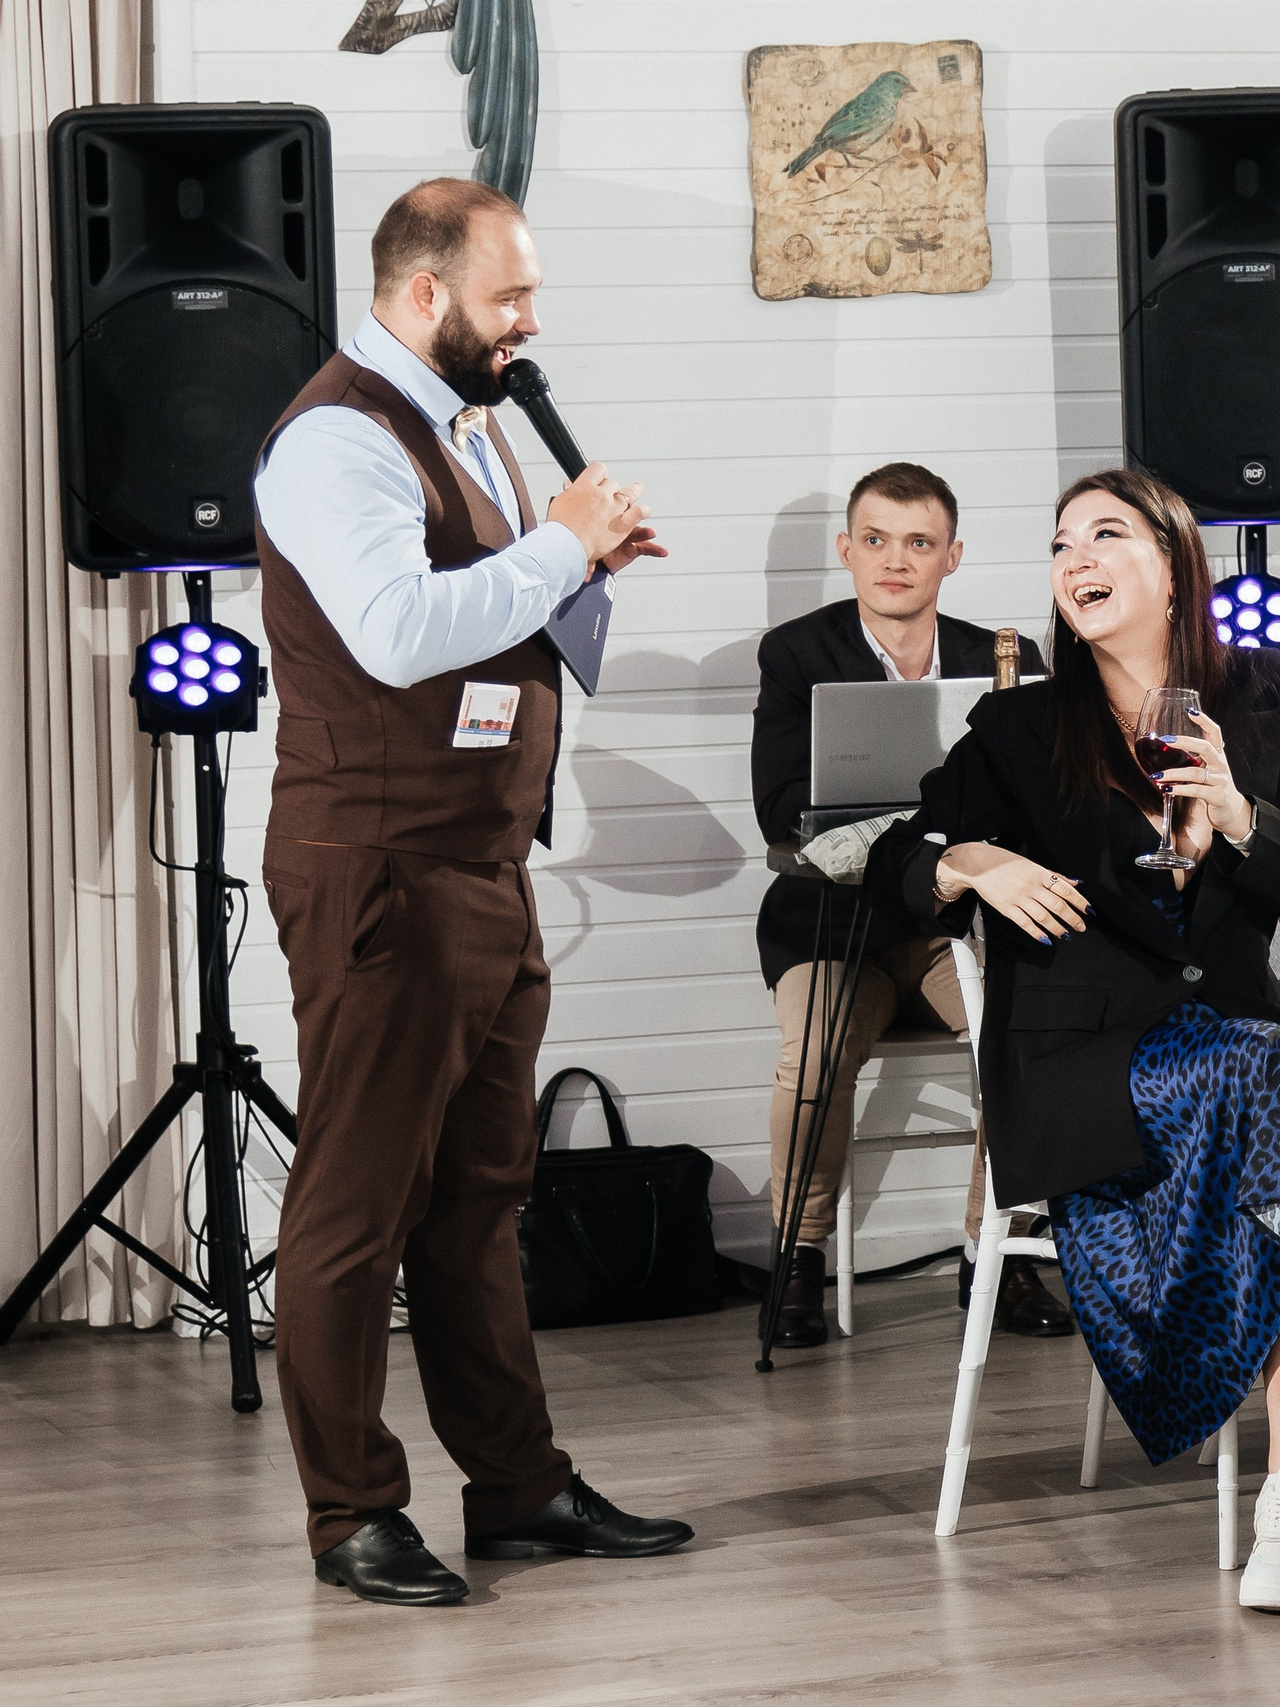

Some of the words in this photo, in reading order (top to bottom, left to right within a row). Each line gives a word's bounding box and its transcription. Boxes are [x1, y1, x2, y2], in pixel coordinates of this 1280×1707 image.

[177, 291, 195, 299] ART
[1246, 469, 1263, 478] RCF
[198, 510, 217, 520] RCF
